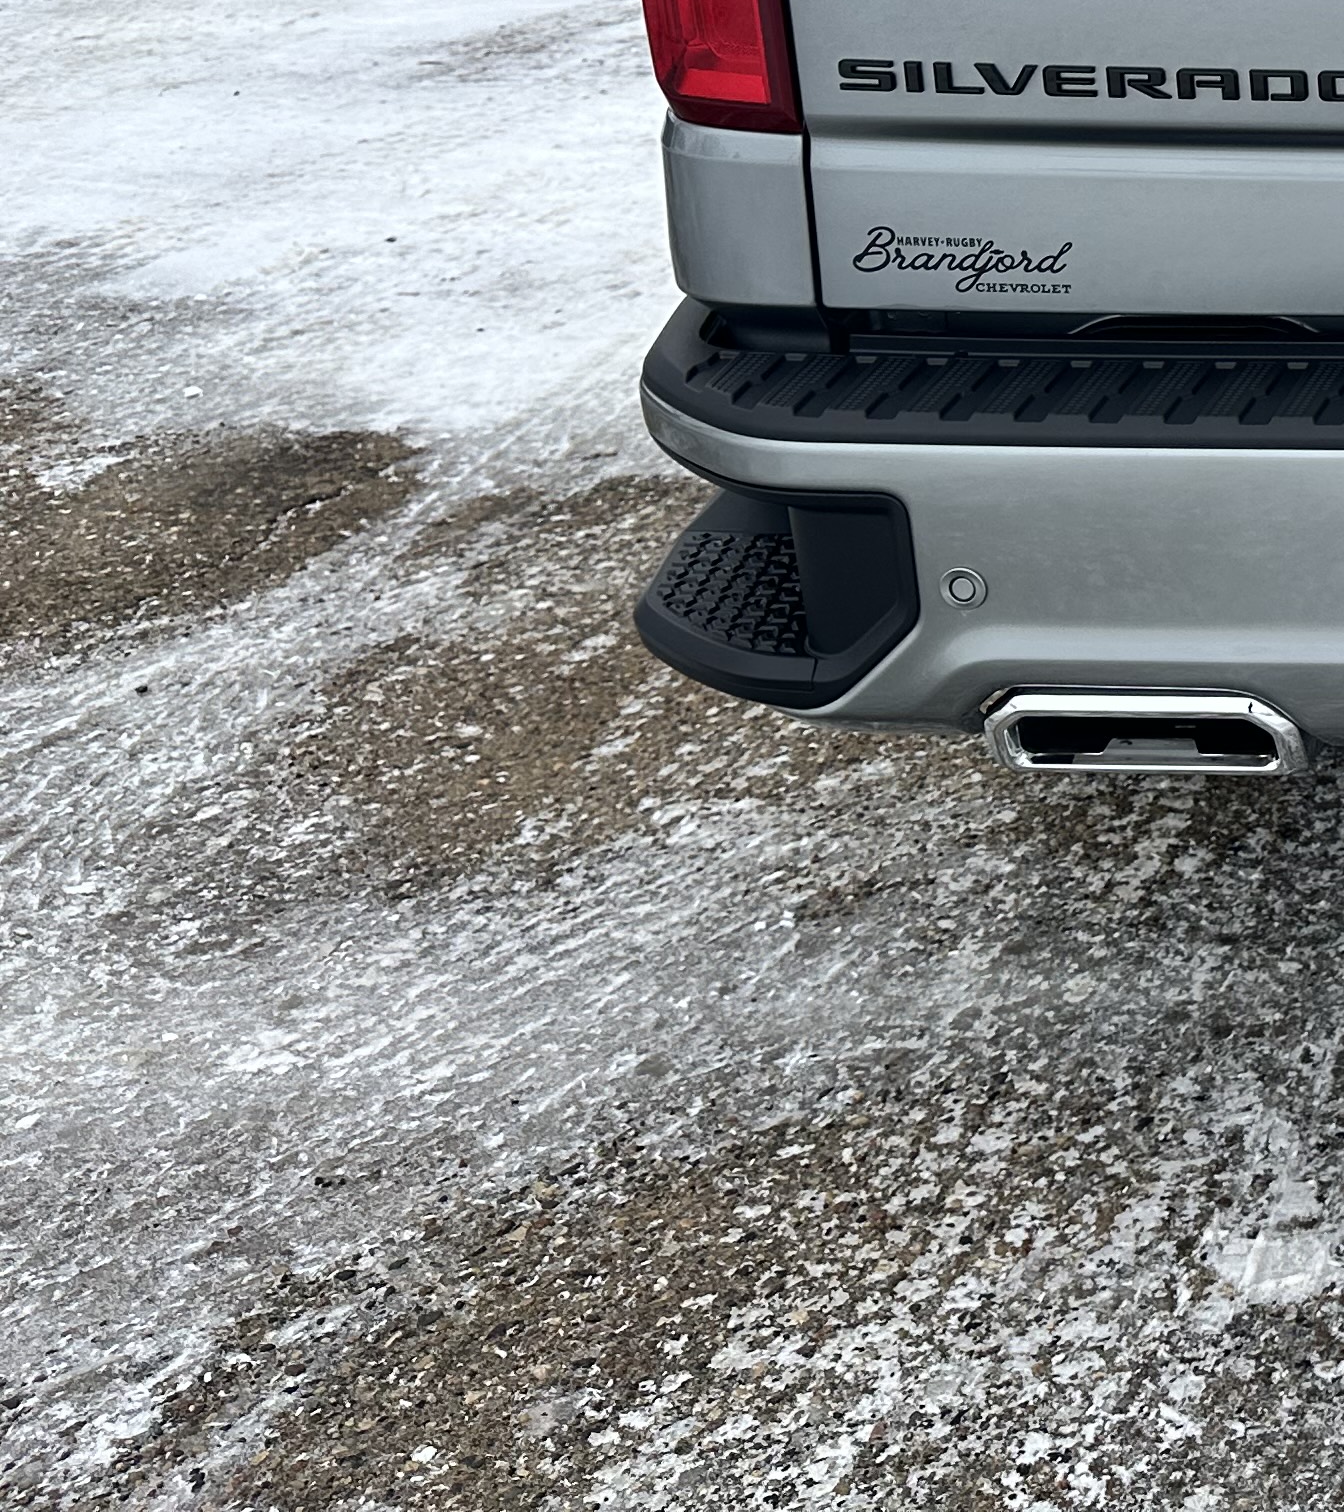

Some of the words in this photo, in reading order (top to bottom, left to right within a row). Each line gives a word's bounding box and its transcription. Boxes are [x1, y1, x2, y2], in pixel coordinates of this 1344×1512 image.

[896, 236, 940, 247] HARVEY
[946, 237, 983, 248] RUGBY
[852, 226, 1073, 293] Brandjord
[974, 282, 1073, 294] CHEVROLET
